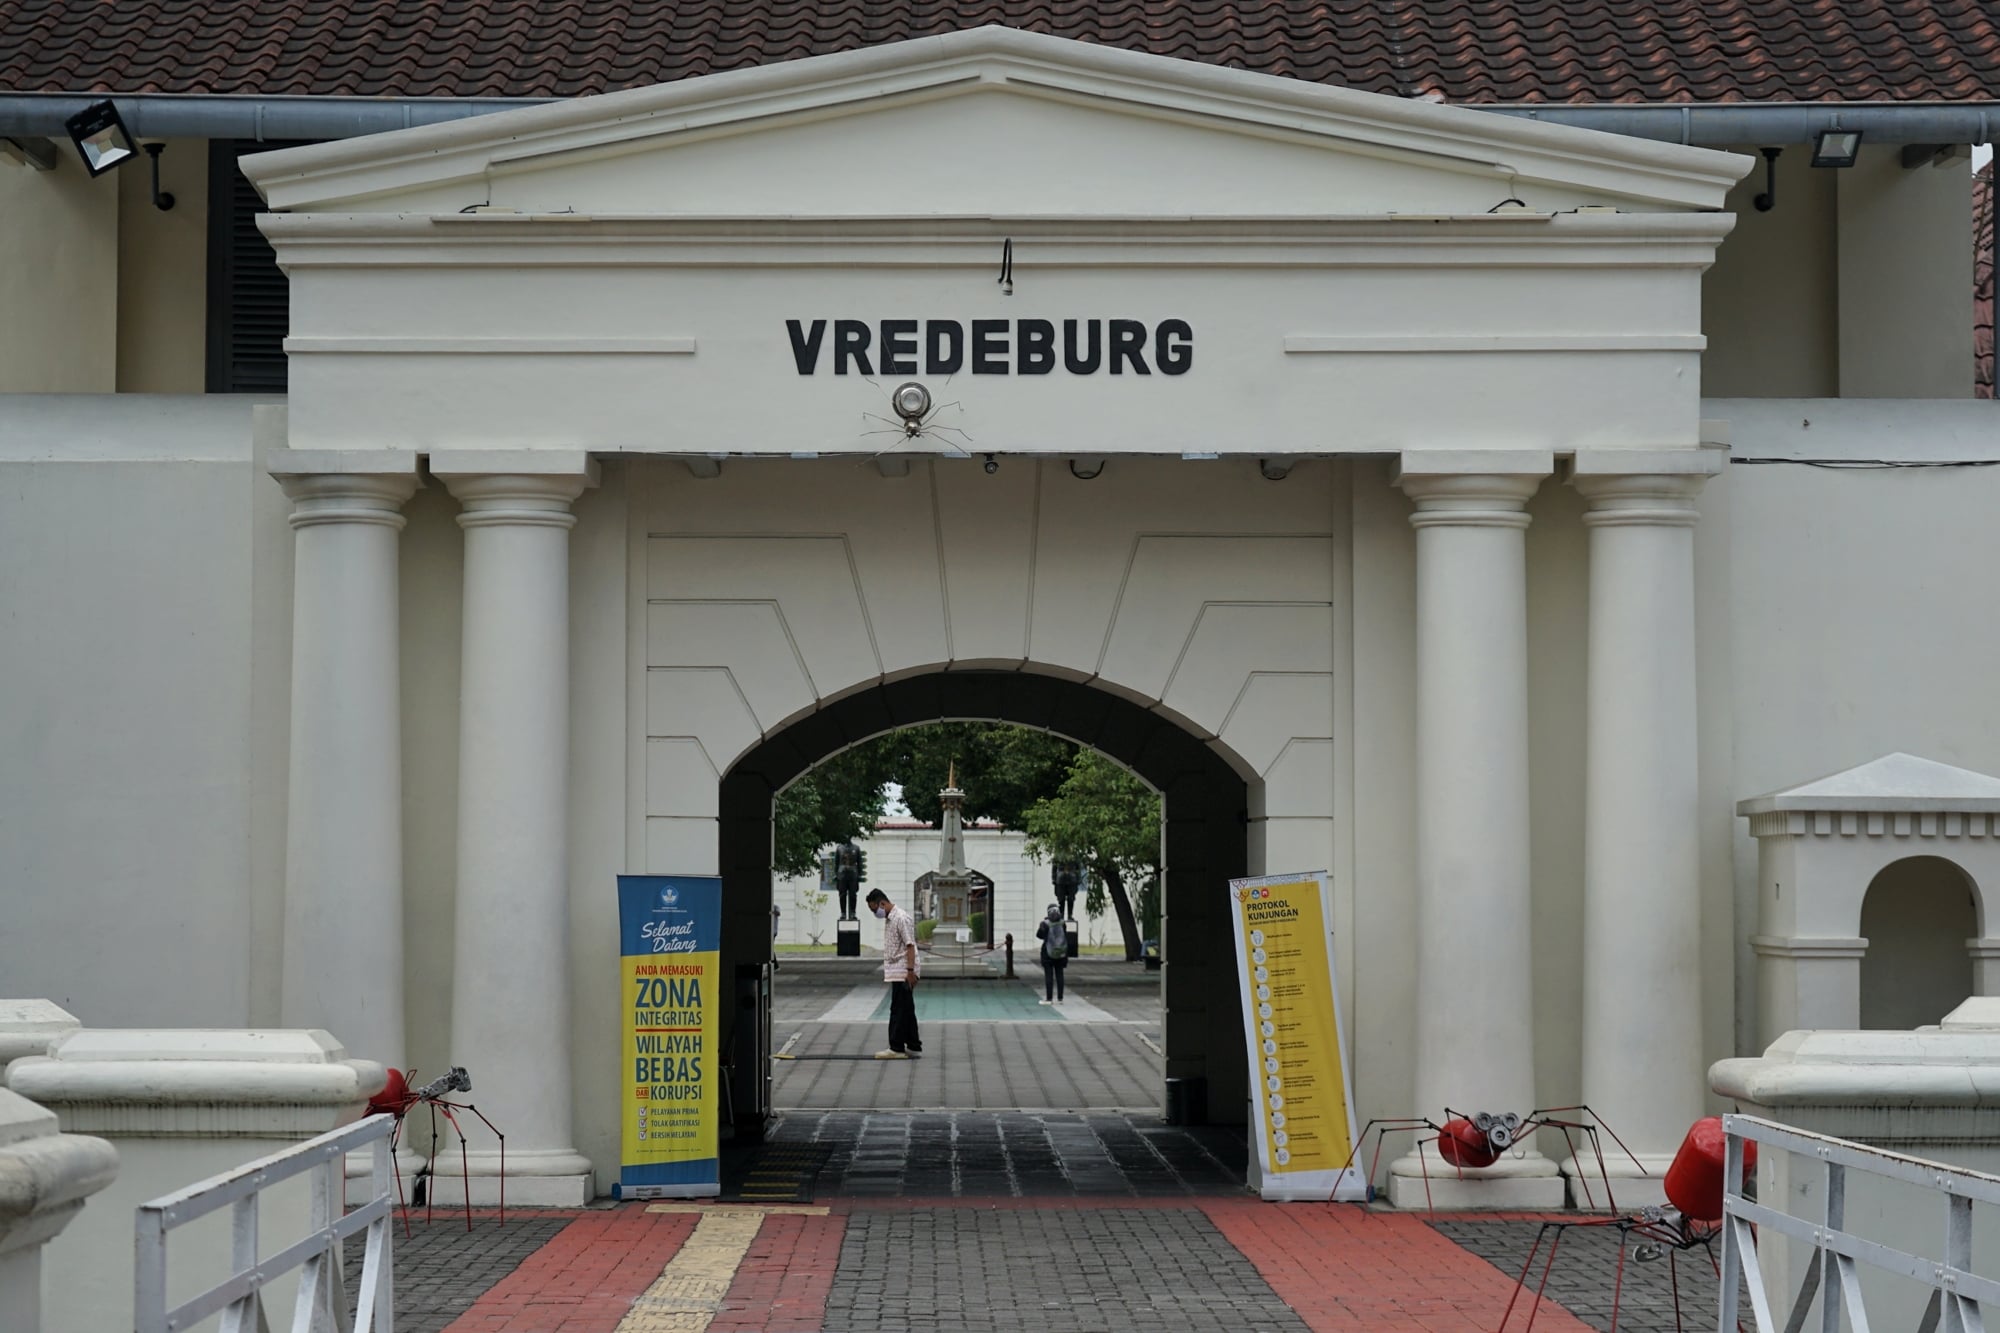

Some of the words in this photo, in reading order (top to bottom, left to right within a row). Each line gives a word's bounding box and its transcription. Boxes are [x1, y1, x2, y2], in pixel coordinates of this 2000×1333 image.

[786, 319, 1193, 376] VREDEBURG
[1247, 900, 1290, 911] PROTOKOL
[1248, 908, 1299, 920] KUNJUNGAN
[641, 920, 694, 938] Selamat
[653, 937, 697, 954] Datang
[635, 965, 658, 976] ANDA
[660, 965, 703, 976] MEMASUKI
[635, 978, 702, 1008] ZONA
[635, 1011, 702, 1026] INTEGRITAS
[636, 1035, 702, 1054] WILAYAH
[636, 1057, 702, 1082] BEBAS
[651, 1085, 702, 1100] KORUPSI
[682, 1107, 699, 1115] PRIMA
[651, 1119, 668, 1128] TOLAK
